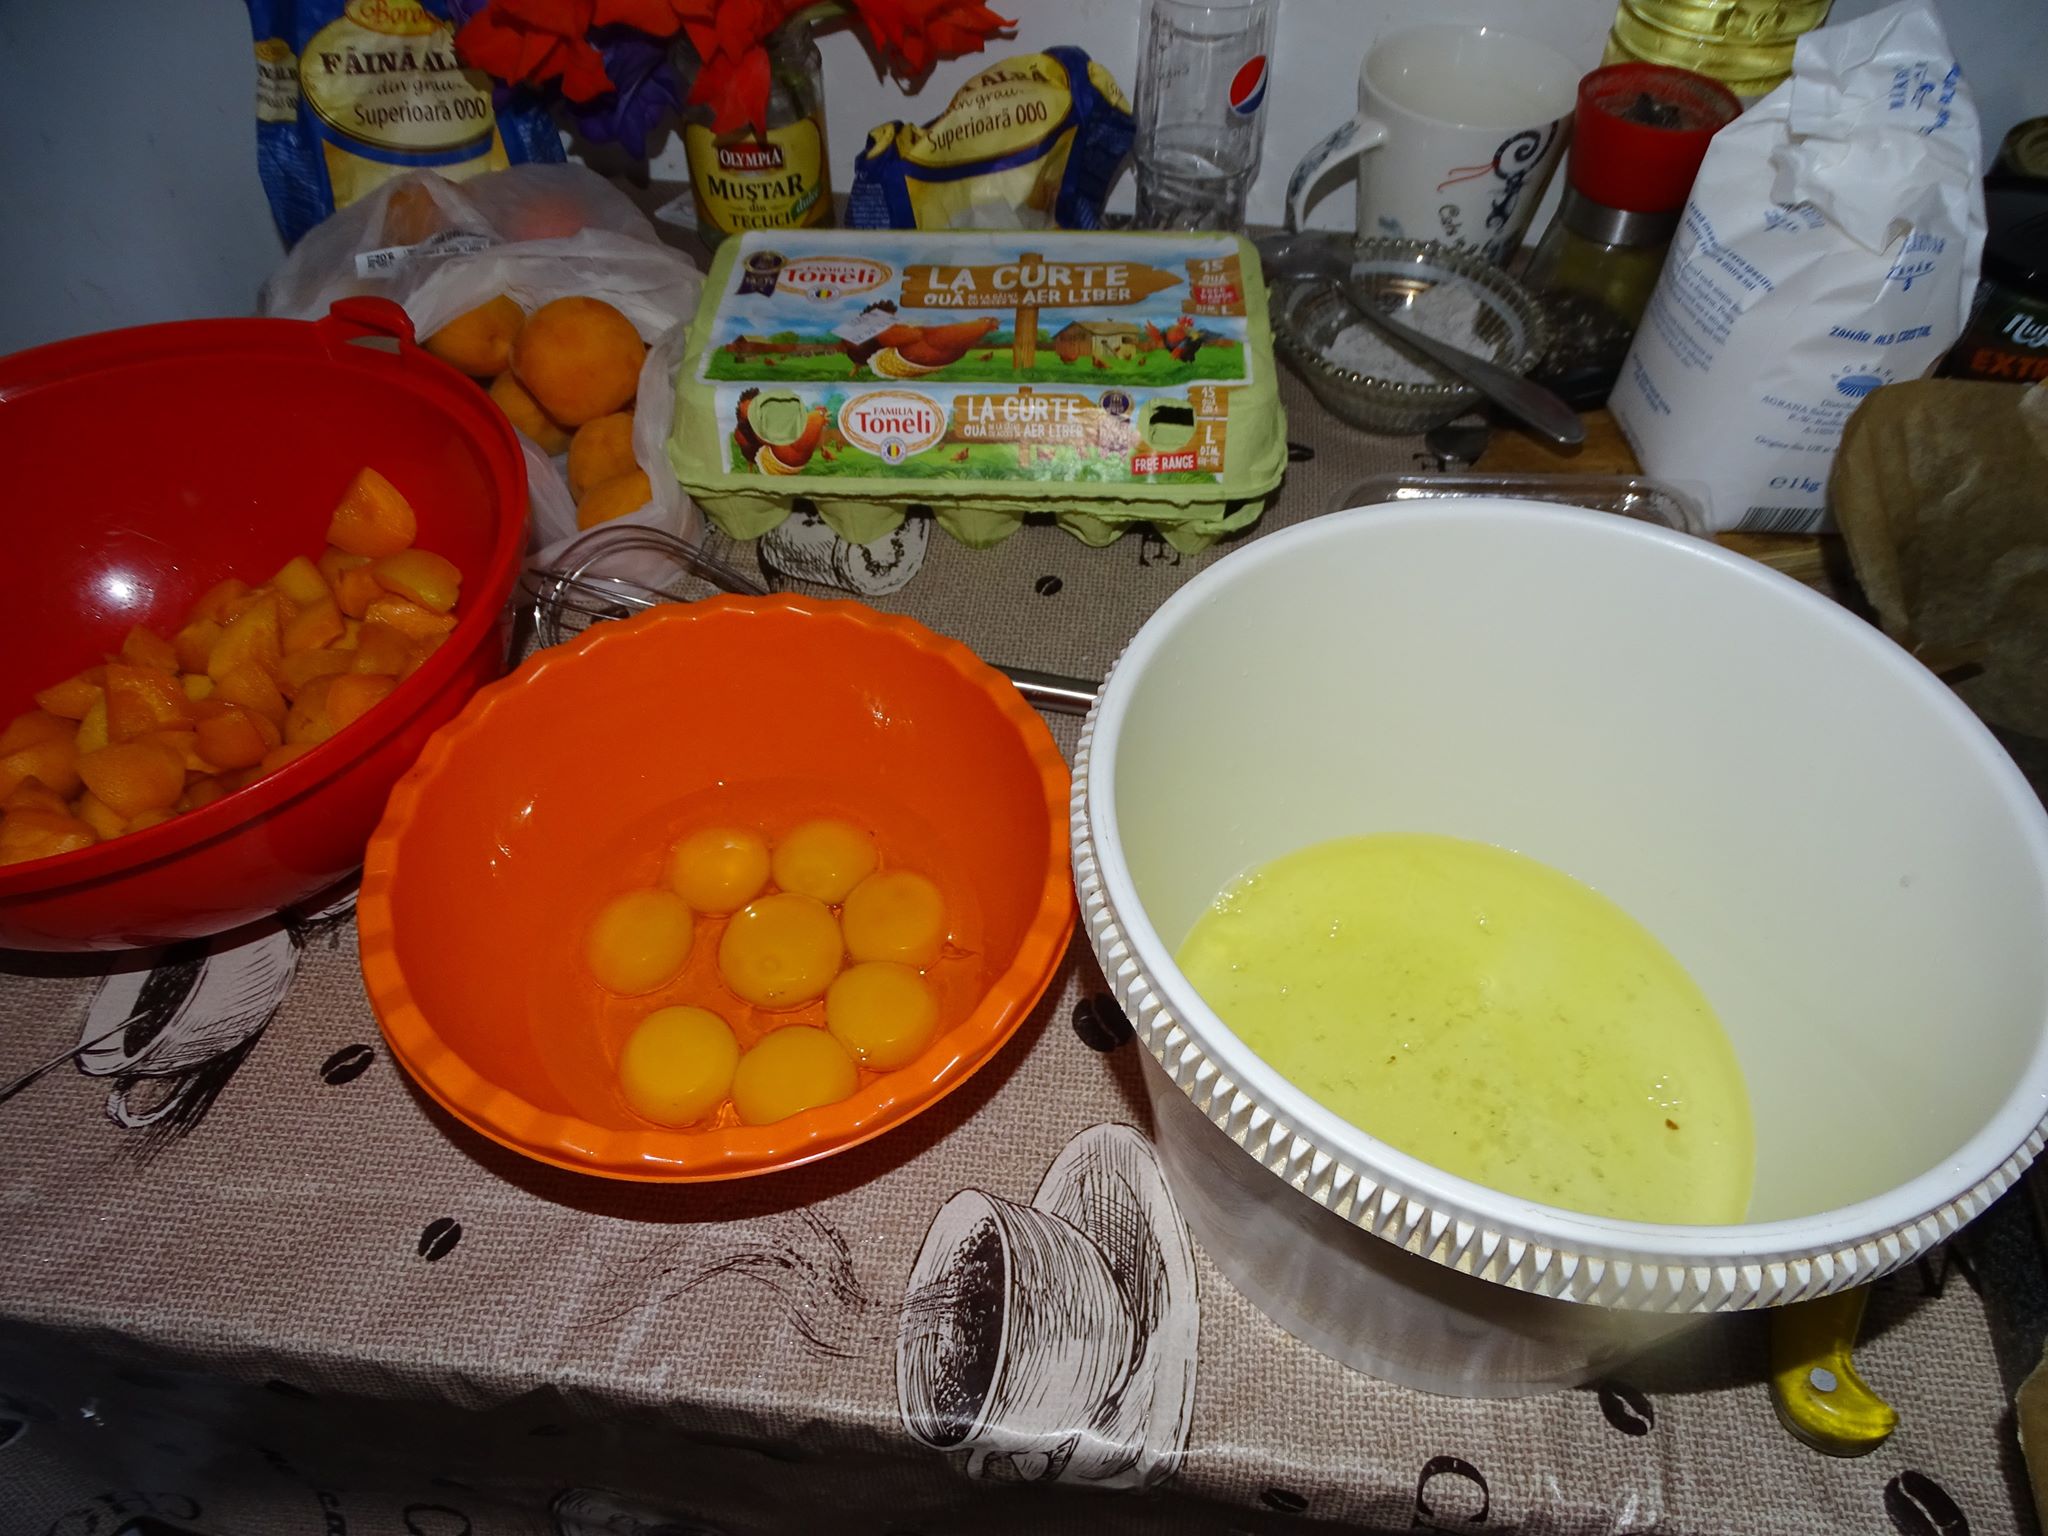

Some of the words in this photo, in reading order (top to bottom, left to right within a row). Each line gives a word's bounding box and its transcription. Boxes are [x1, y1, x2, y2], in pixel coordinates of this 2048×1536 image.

[354, 98, 452, 128] Superioară
[454, 96, 487, 122] 000
[927, 109, 1011, 154] Superioară
[1015, 100, 1047, 125] 000
[720, 147, 782, 168] OLYMPIA
[729, 210, 791, 229] TECUCI
[784, 268, 876, 284] Toneli
[928, 265, 976, 291] LA
[992, 264, 1129, 291] CURTE
[923, 288, 964, 306] OUĂ
[1022, 288, 1061, 305] AER
[1068, 287, 1131, 303] LIBER
[1202, 386, 1216, 397] 15
[873, 407, 913, 416] FAMILIA
[967, 396, 995, 422] LA
[1003, 395, 1080, 423] CURTE
[855, 410, 931, 434] Toneli
[964, 422, 987, 438] OUĂ
[1023, 423, 1045, 438] AER
[1205, 425, 1216, 444] L
[1134, 457, 1159, 473] FREE
[1161, 454, 1194, 471] RANGE
[1799, 476, 1823, 493] kg
